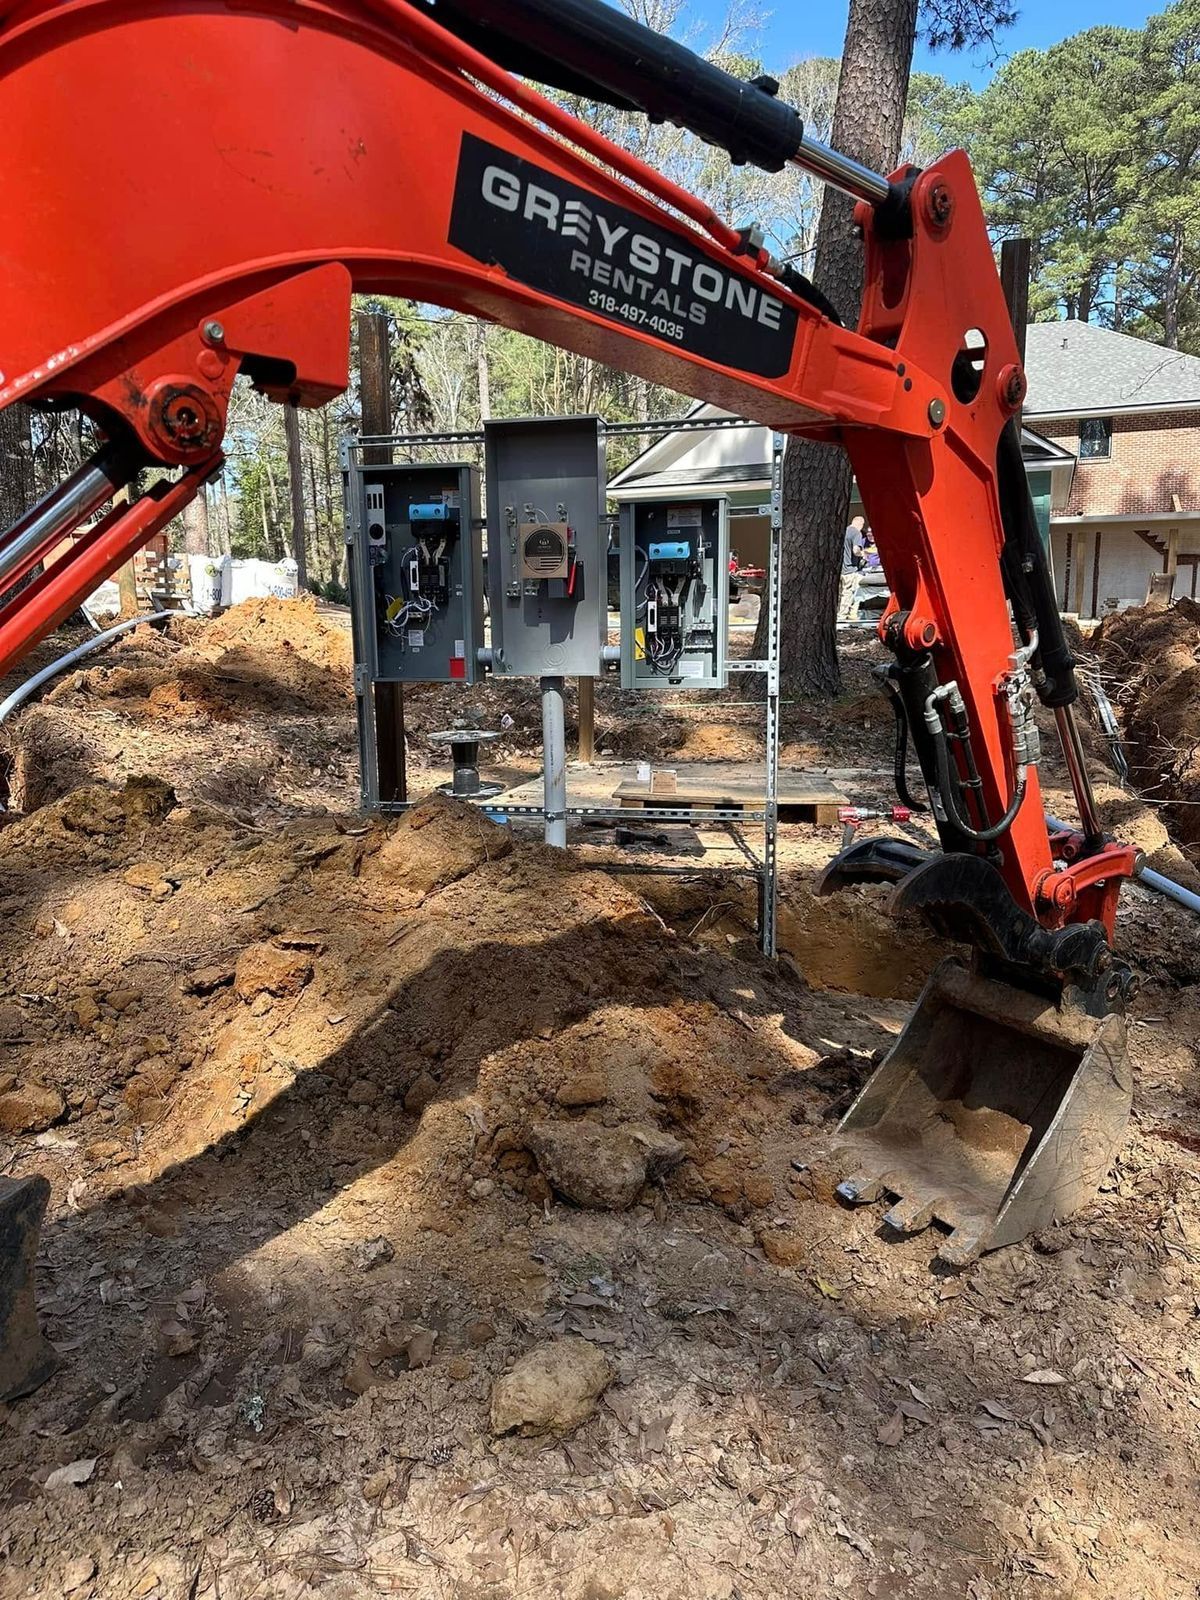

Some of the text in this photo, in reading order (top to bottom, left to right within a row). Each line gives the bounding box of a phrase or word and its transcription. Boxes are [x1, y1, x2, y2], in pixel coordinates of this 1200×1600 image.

[481, 166, 784, 331] GREYSTONE
[570, 250, 707, 325] RENTALS
[588, 289, 684, 340] 318-497-4035
